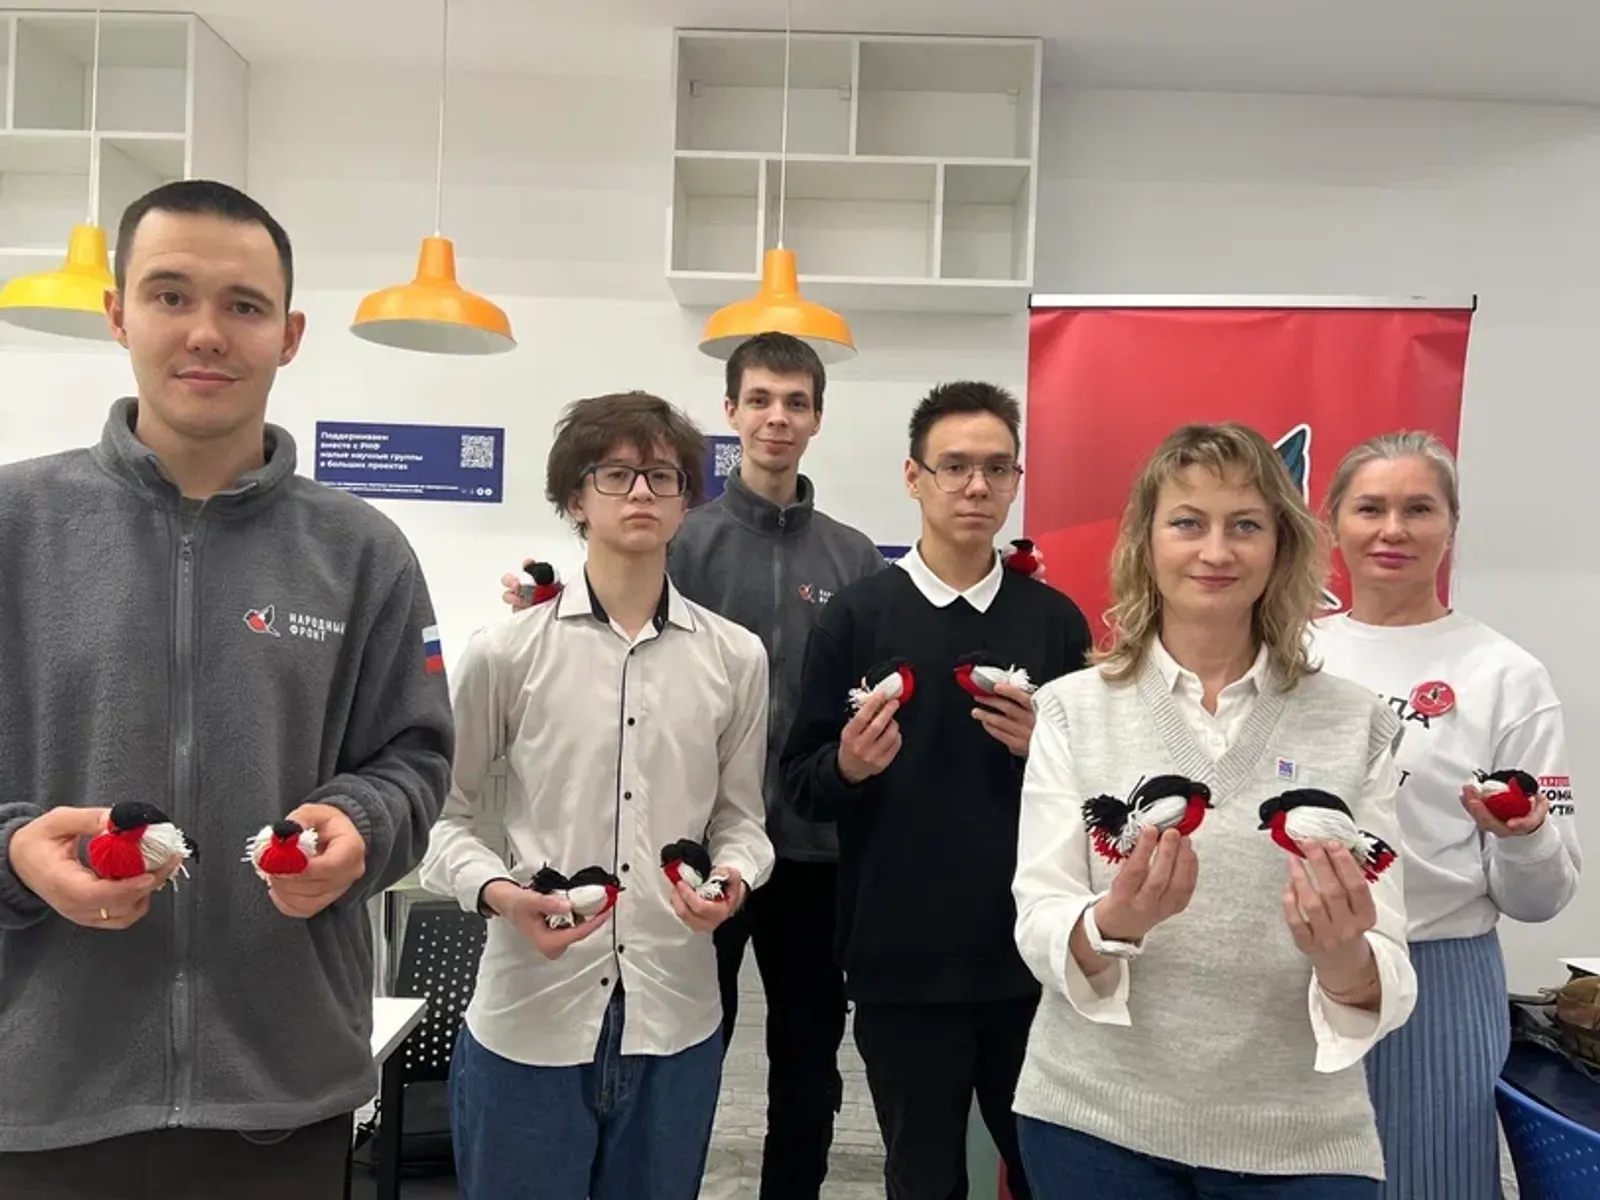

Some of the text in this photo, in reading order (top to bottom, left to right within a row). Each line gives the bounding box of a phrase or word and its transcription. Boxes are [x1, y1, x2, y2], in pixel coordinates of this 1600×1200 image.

[351, 452, 389, 460] научные
[391, 454, 423, 462] группы
[327, 460, 366, 469] больших
[367, 462, 408, 471] проектах
[289, 624, 325, 642] ФРОНТ
